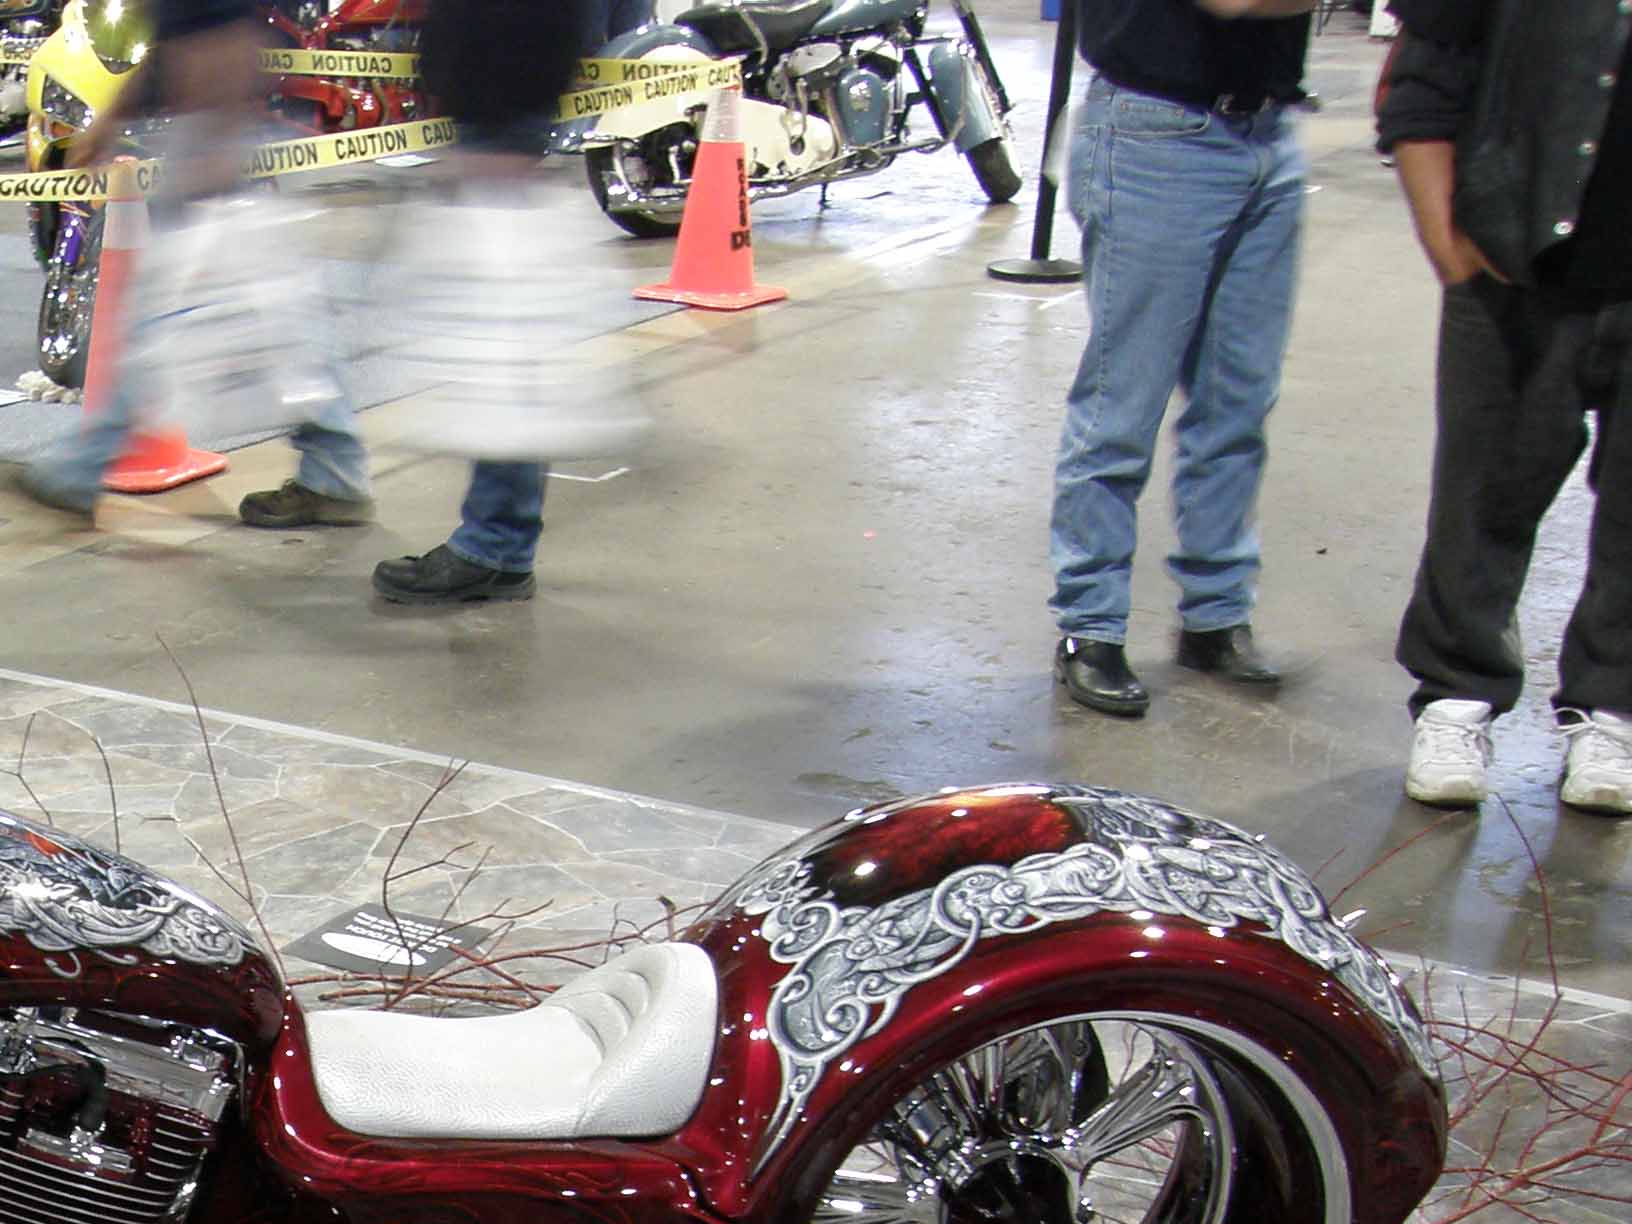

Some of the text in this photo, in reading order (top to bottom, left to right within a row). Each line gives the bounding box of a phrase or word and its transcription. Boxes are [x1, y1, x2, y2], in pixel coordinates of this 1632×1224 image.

[575, 87, 633, 115] CAUTION
[644, 73, 697, 100] CAUTION
[335, 129, 408, 160] CAUTION
